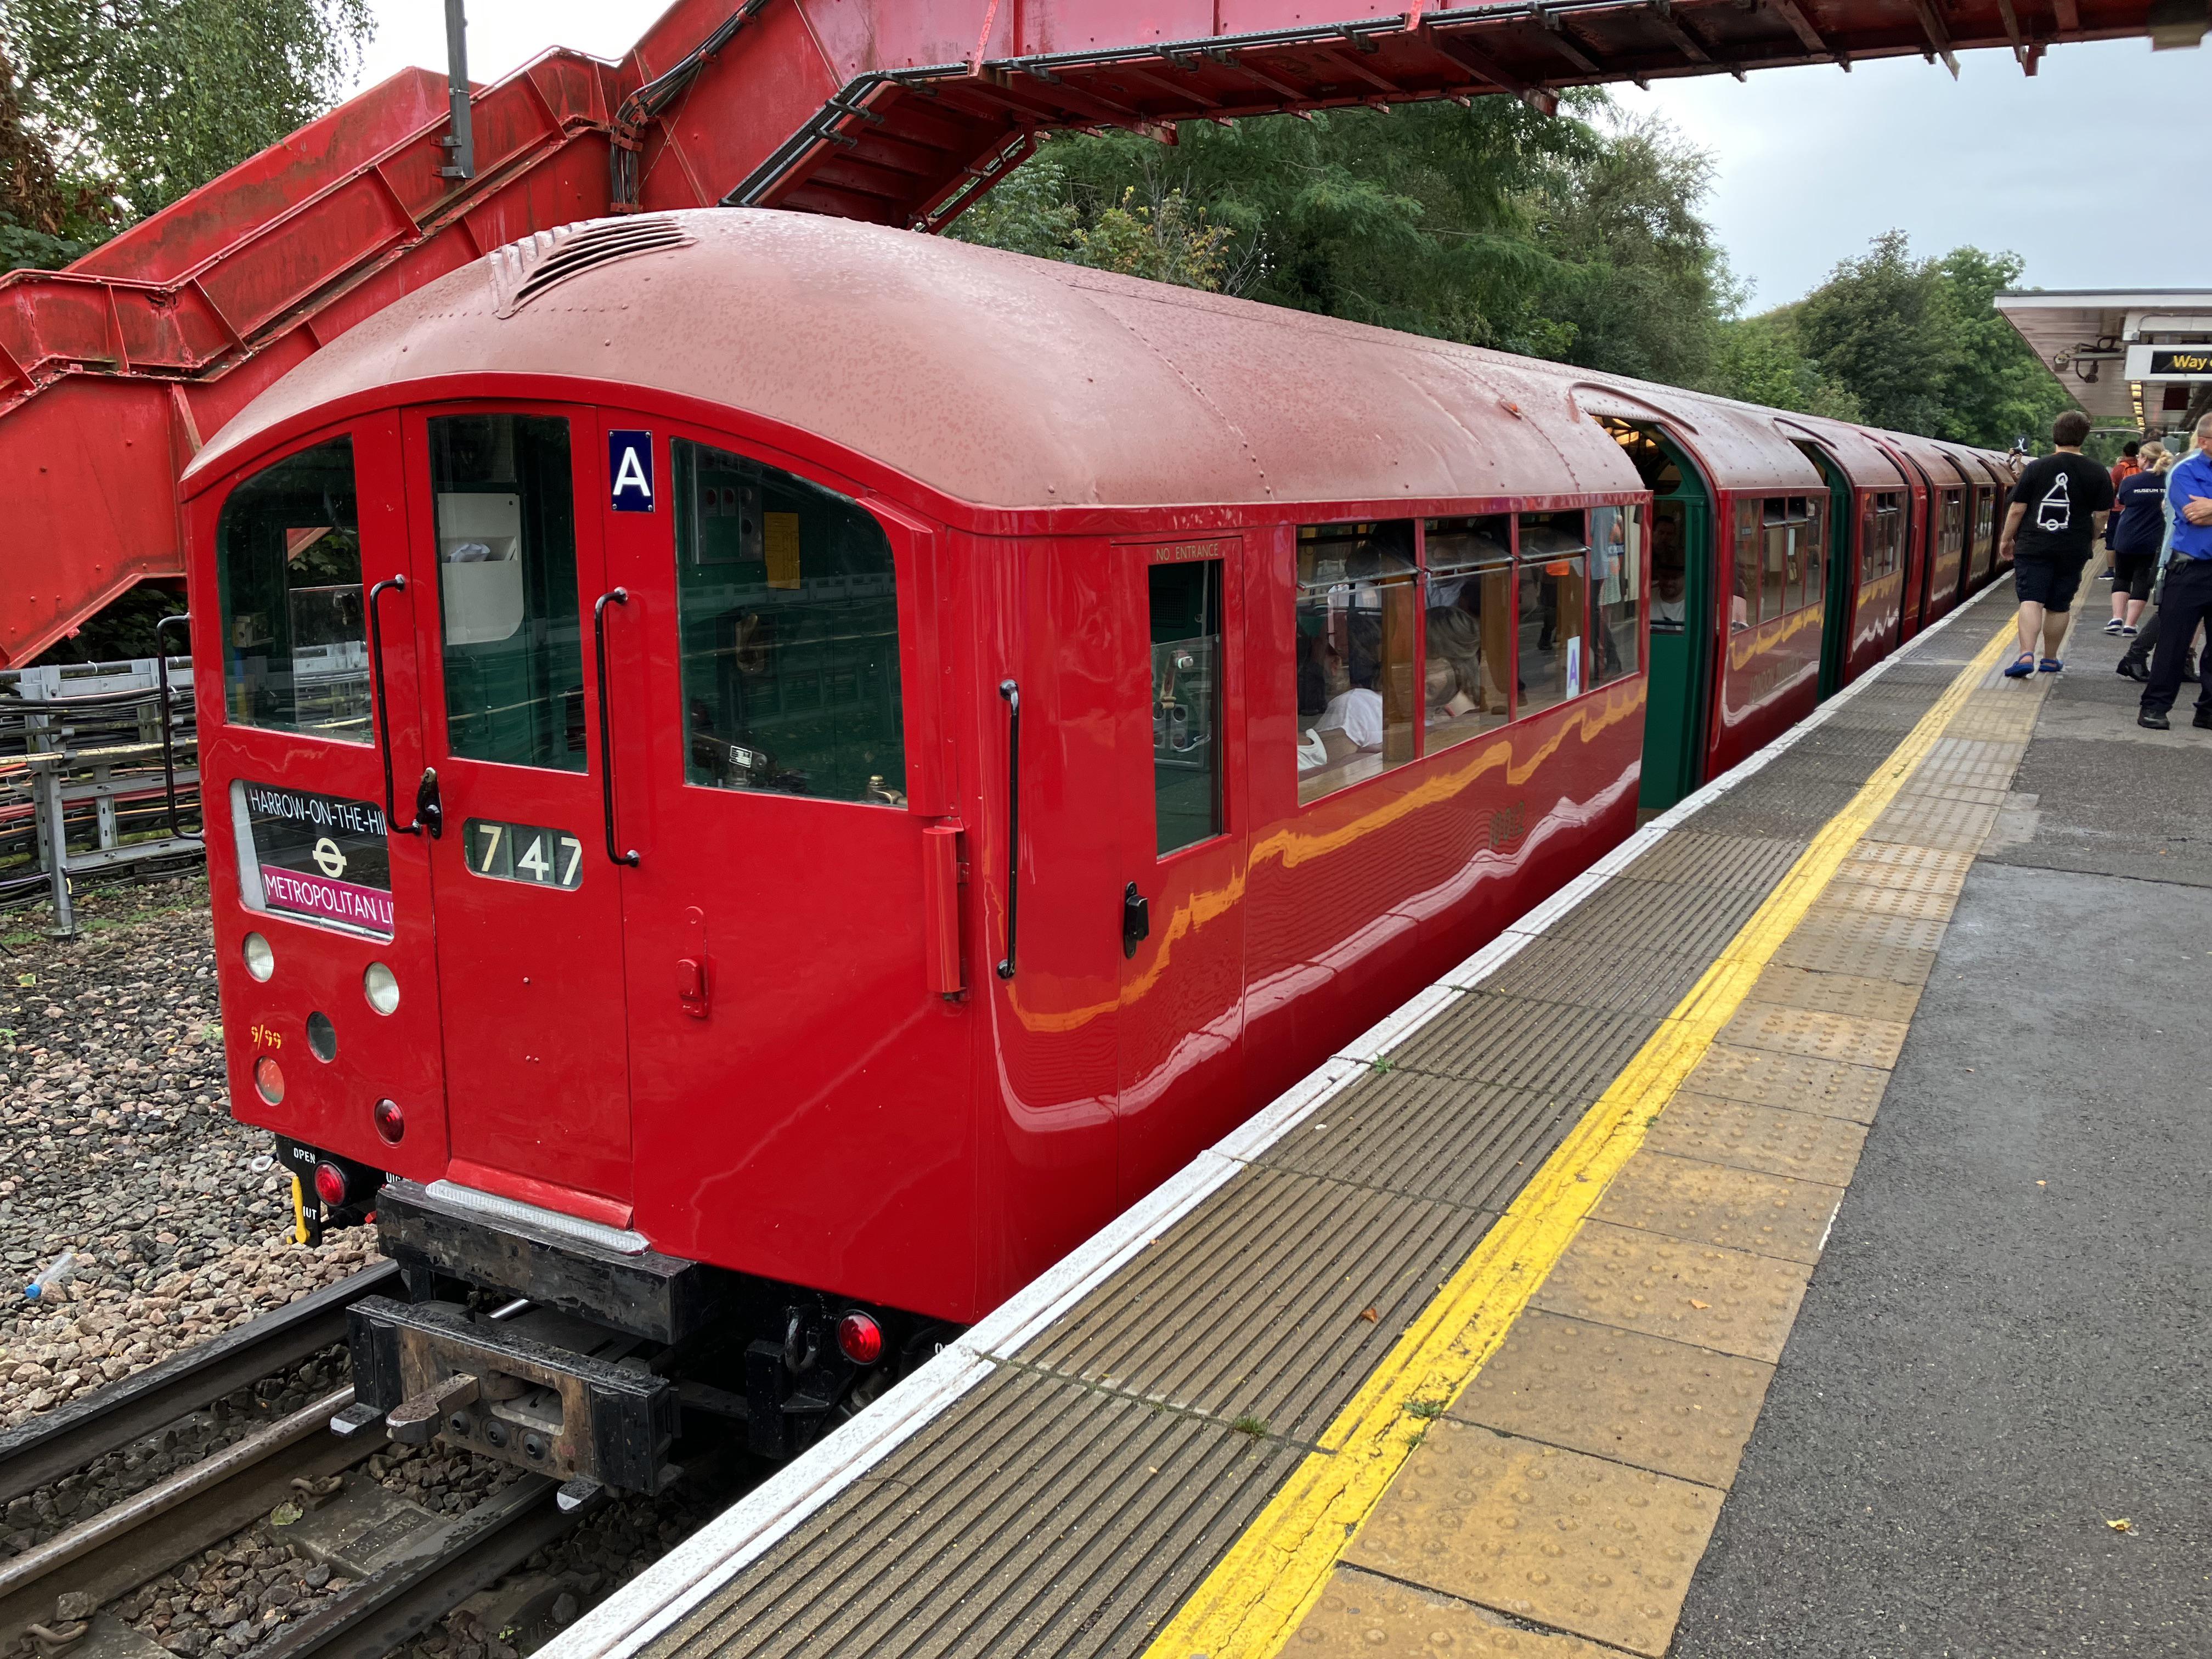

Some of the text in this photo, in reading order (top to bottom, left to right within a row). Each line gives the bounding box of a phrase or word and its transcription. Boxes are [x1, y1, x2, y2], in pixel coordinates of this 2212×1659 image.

[2173, 354, 2208, 370] Way
[612, 446, 652, 496] A
[1156, 543, 1218, 561] NO ENTRANCE
[1568, 648, 1579, 689] A
[264, 873, 394, 924] METROPOLITAN LI
[251, 1024, 281, 1051] 9/99
[293, 1147, 316, 1165] OPEN
